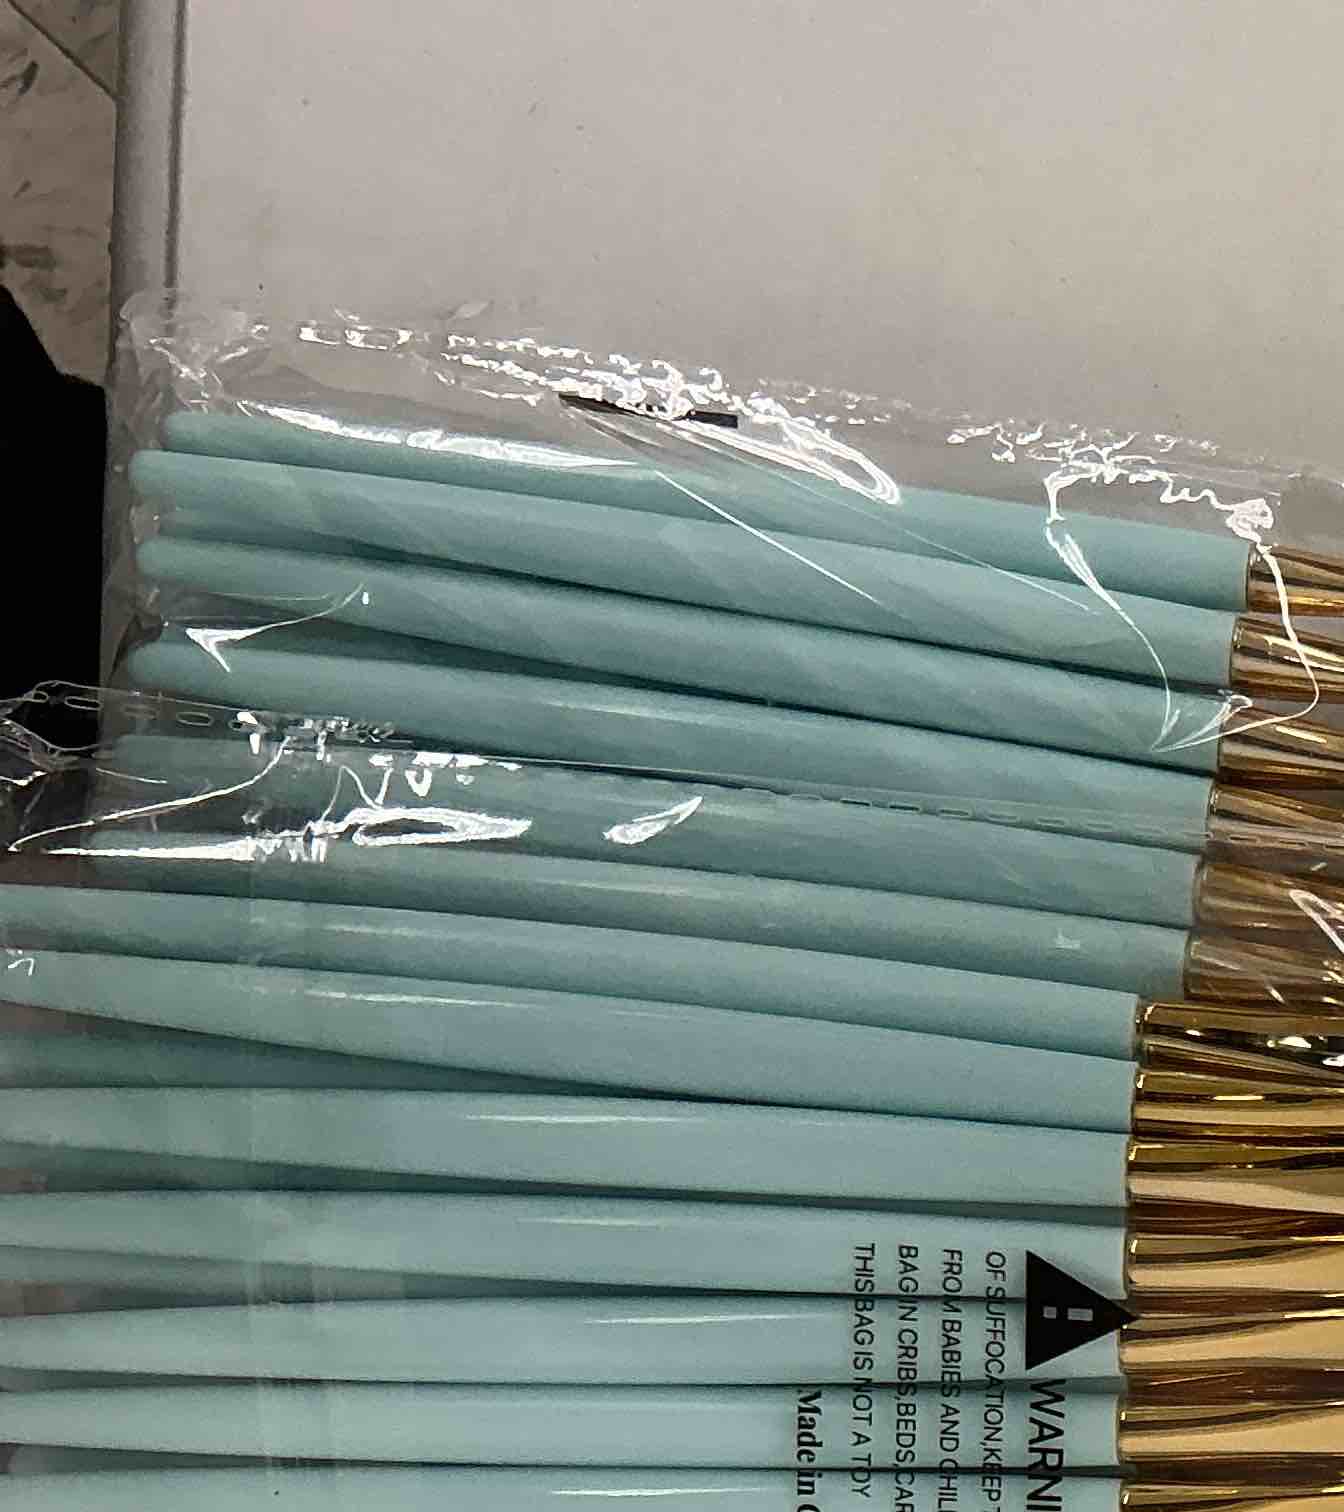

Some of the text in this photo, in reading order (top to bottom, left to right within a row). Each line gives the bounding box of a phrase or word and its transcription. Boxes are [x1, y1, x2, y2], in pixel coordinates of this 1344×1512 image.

[899, 1245, 918, 1292] BAG
[943, 1249, 962, 1312] FROM
[986, 1252, 1006, 1281] OF
[899, 1299, 917, 1321] IN
[851, 1244, 874, 1498] THIS BAG IS NOT A TOY
[941, 1320, 962, 1397] BABIES
[796, 1390, 822, 1462] Made
[940, 1404, 959, 1451] AND
[797, 1470, 822, 1496] in
